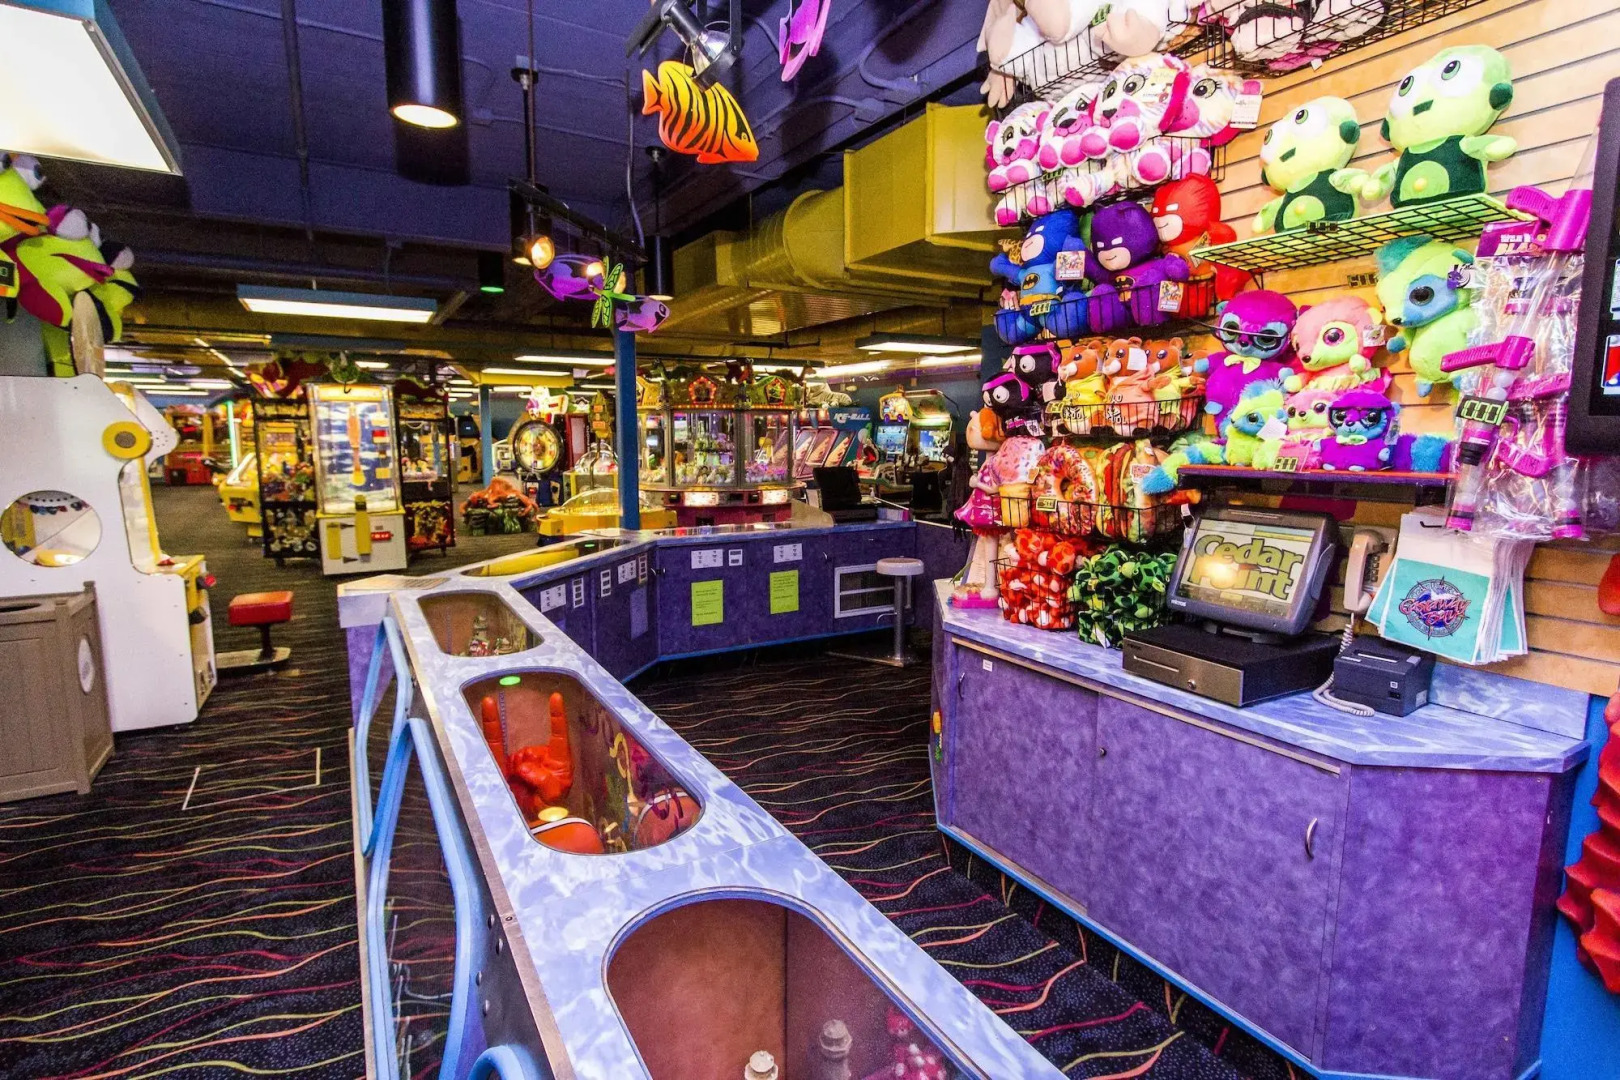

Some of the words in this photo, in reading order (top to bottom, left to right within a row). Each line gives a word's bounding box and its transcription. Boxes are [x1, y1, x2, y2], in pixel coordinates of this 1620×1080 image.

[1194, 534, 1304, 574] Cedar
[1187, 557, 1294, 600] Point
[1399, 598, 1472, 615] Castaway
